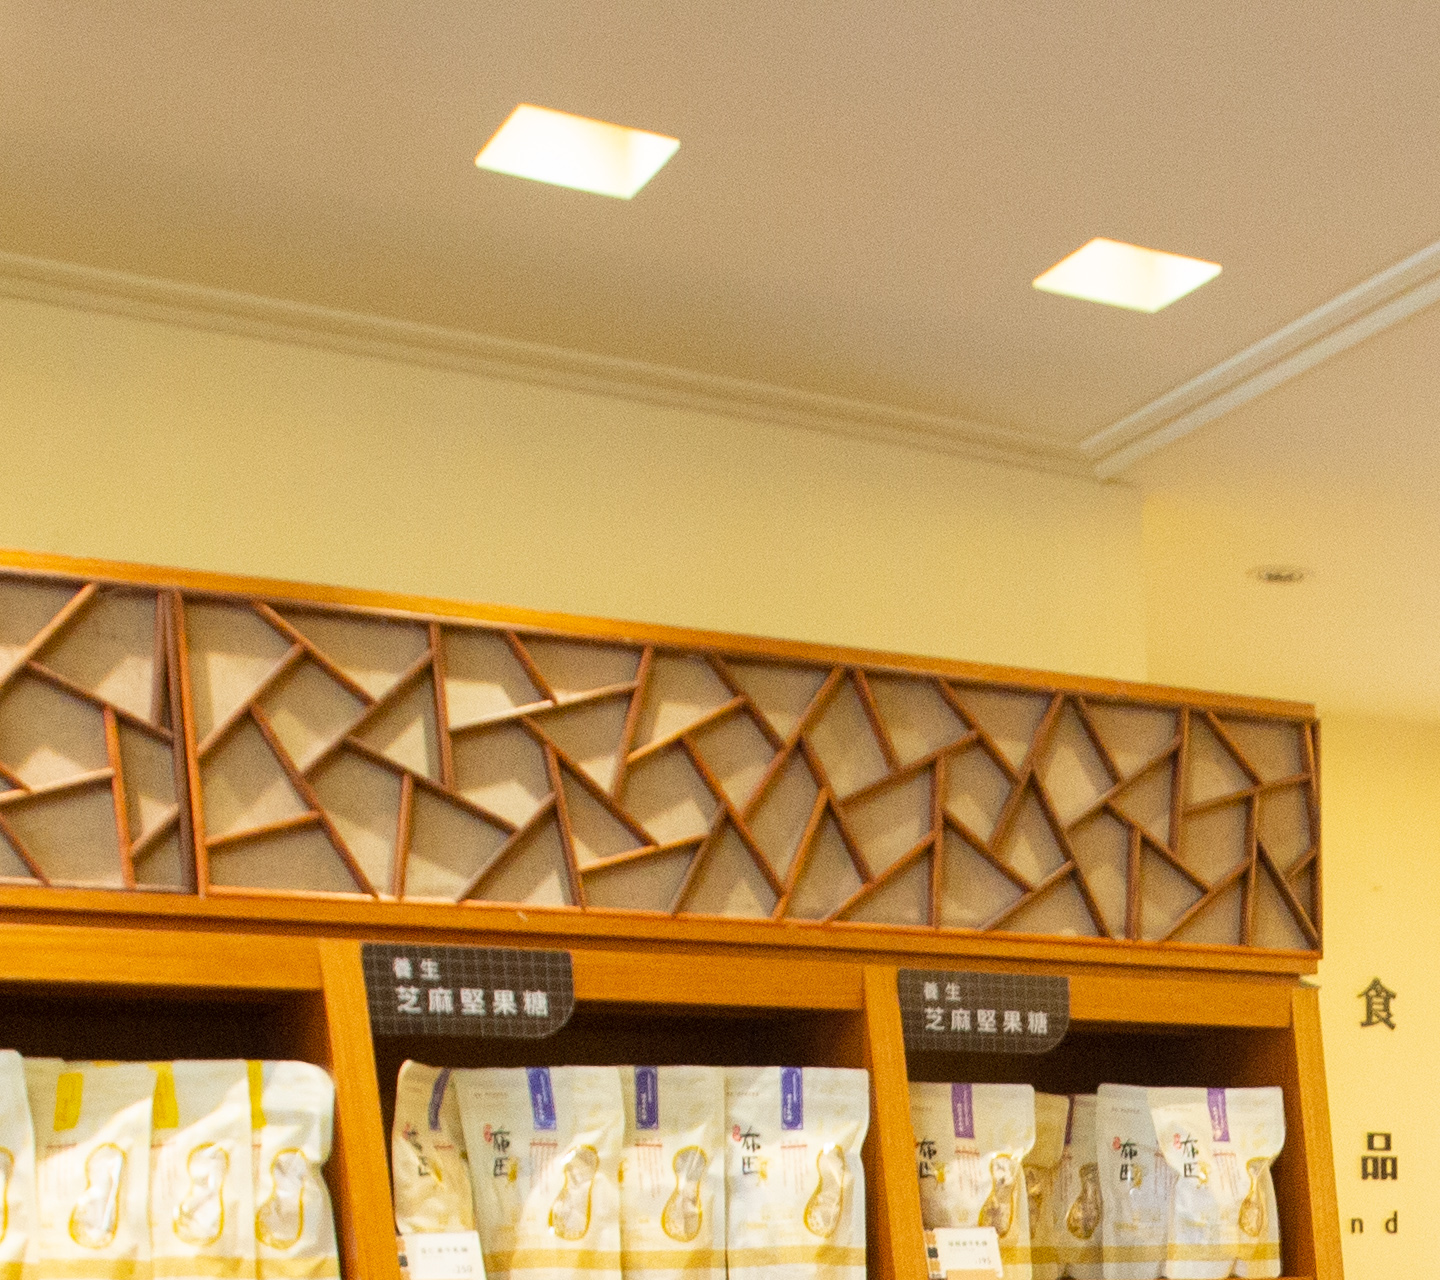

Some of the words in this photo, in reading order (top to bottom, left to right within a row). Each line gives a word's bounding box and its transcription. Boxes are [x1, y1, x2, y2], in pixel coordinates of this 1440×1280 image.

[393, 956, 441, 981] 養生
[397, 987, 551, 1018] 芝麻堅果糖
[923, 981, 962, 1001] 養生
[924, 1007, 1050, 1037] 芝麻堅果糖
